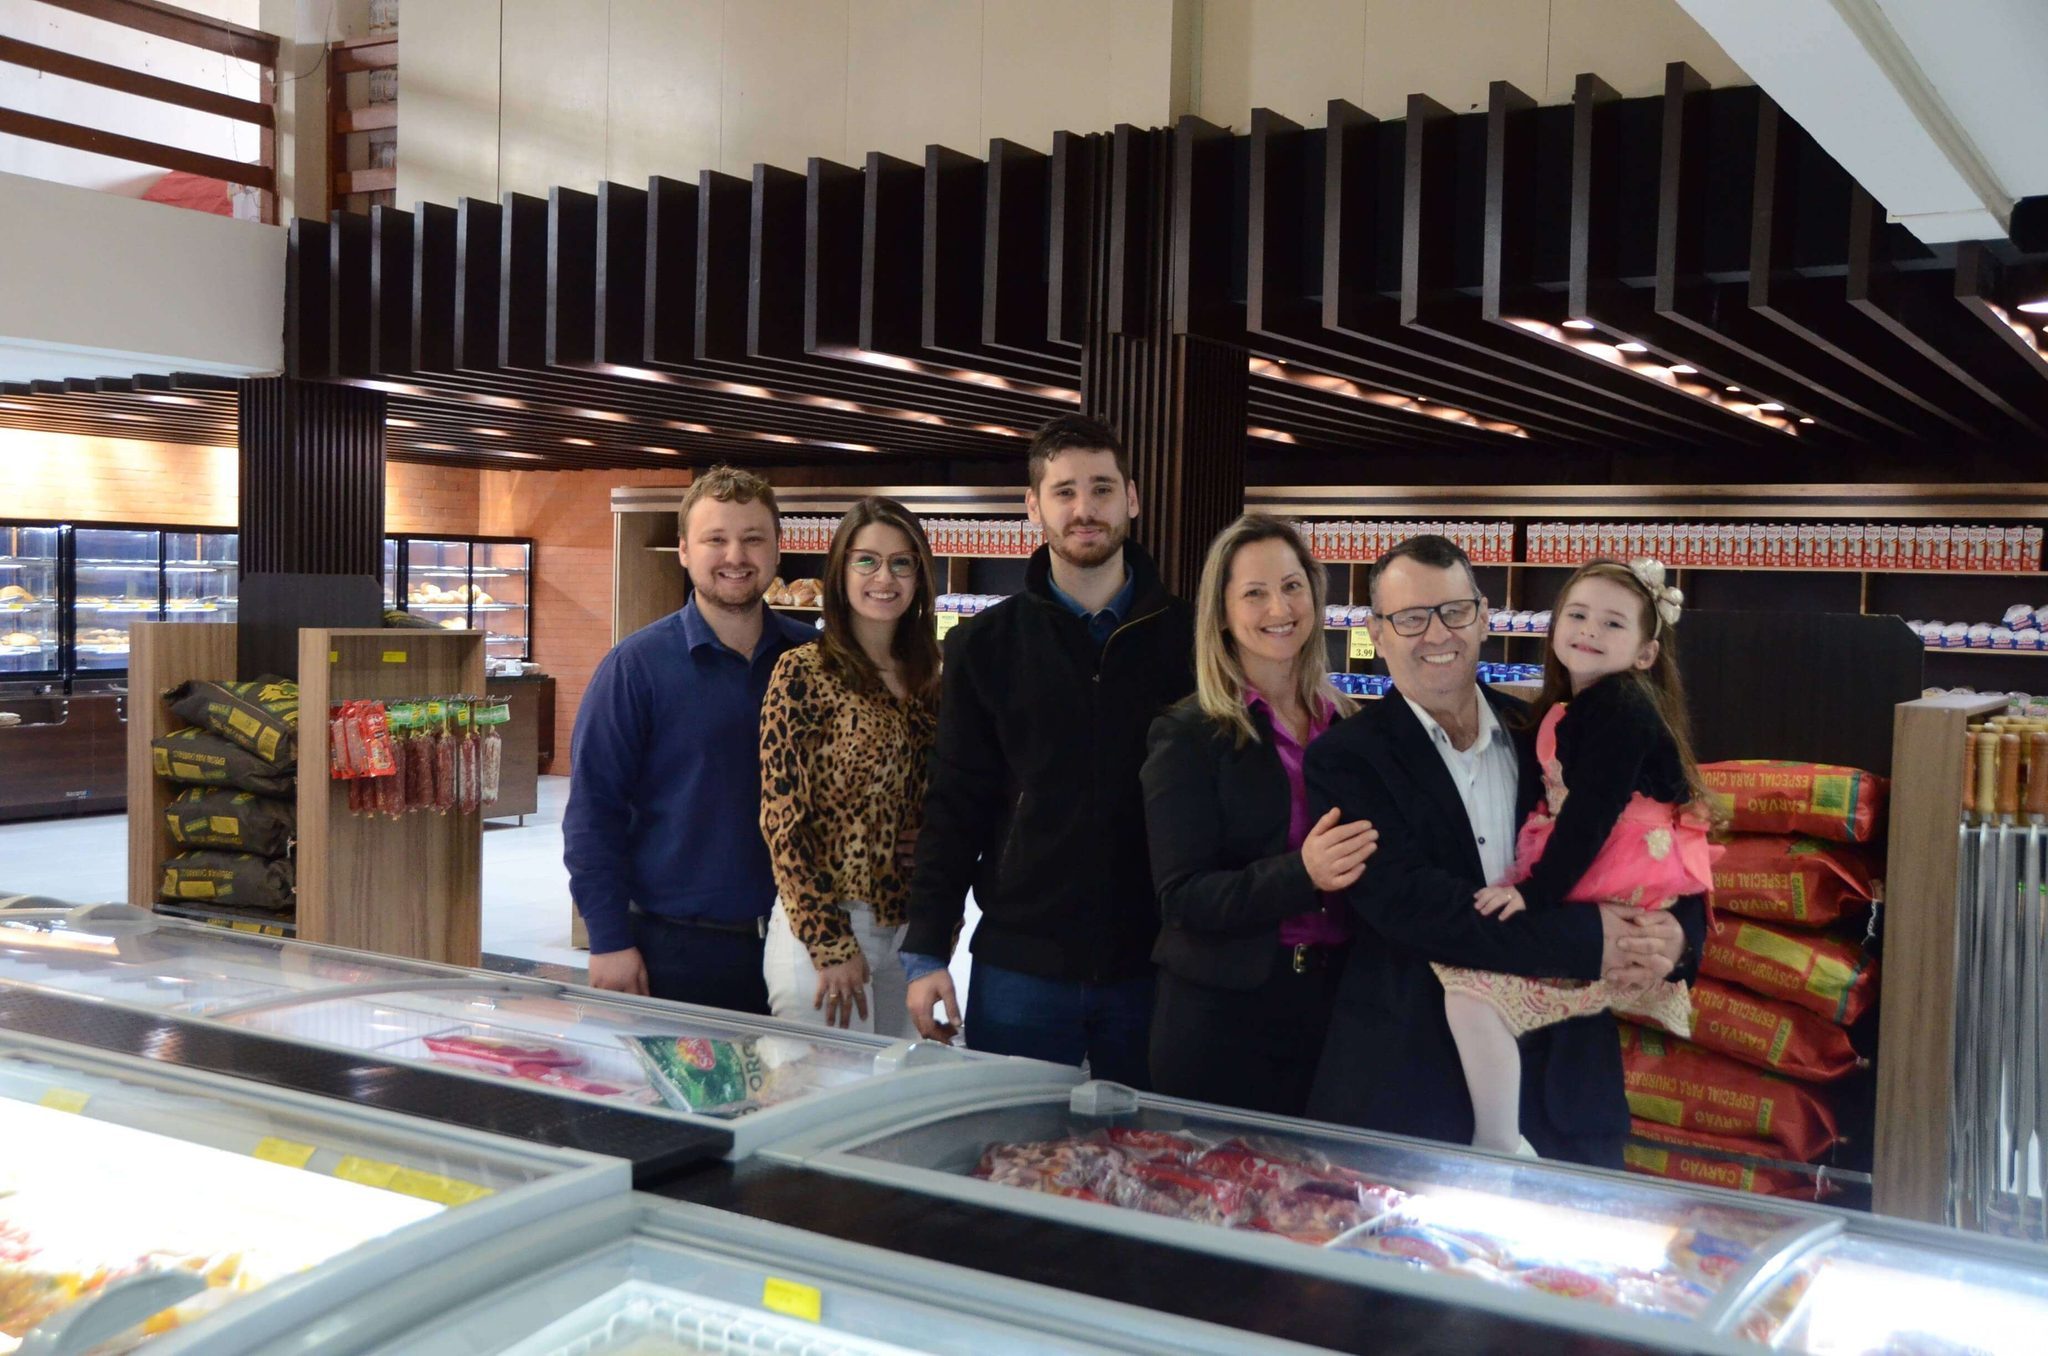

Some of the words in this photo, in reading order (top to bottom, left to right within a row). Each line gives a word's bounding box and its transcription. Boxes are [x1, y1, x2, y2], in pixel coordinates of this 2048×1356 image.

[1356, 649, 1373, 657] 3.99
[1731, 772, 1756, 788] PARA
[1760, 773, 1809, 789] ESPECIAL
[1748, 798, 1807, 815] CARVÃO
[1712, 872, 1736, 889] PAR
[1738, 873, 1789, 890] ESPECIAL
[1708, 945, 1735, 969] PARA
[1737, 956, 1801, 990] CHURRASCO
[1700, 989, 1726, 1011] PARA
[1727, 998, 1777, 1029] ESPECIAL
[1680, 1079, 1704, 1099] PARA
[1708, 1085, 1757, 1110] ESPECIAL
